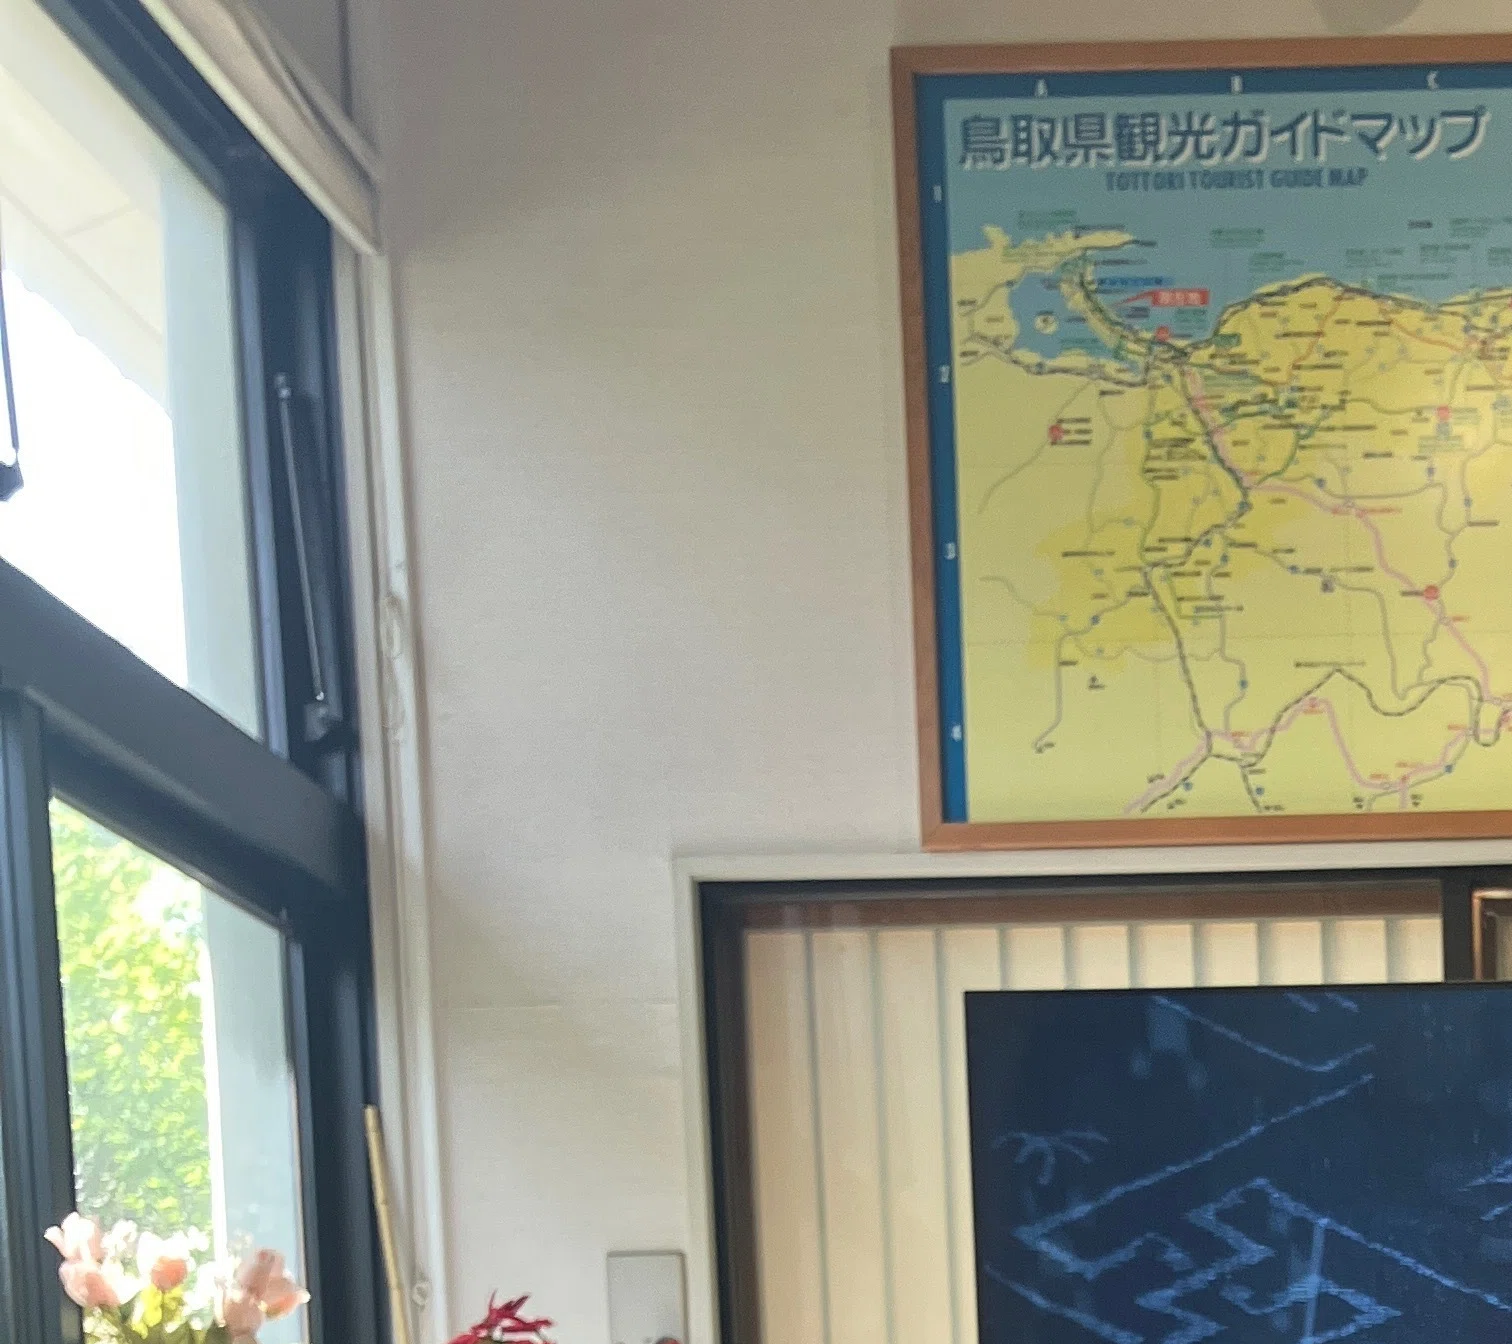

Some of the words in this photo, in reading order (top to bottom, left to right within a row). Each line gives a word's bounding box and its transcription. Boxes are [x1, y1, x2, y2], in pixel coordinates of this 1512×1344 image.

[960, 104, 1489, 169] 鳥取県観光ガイドマップ
